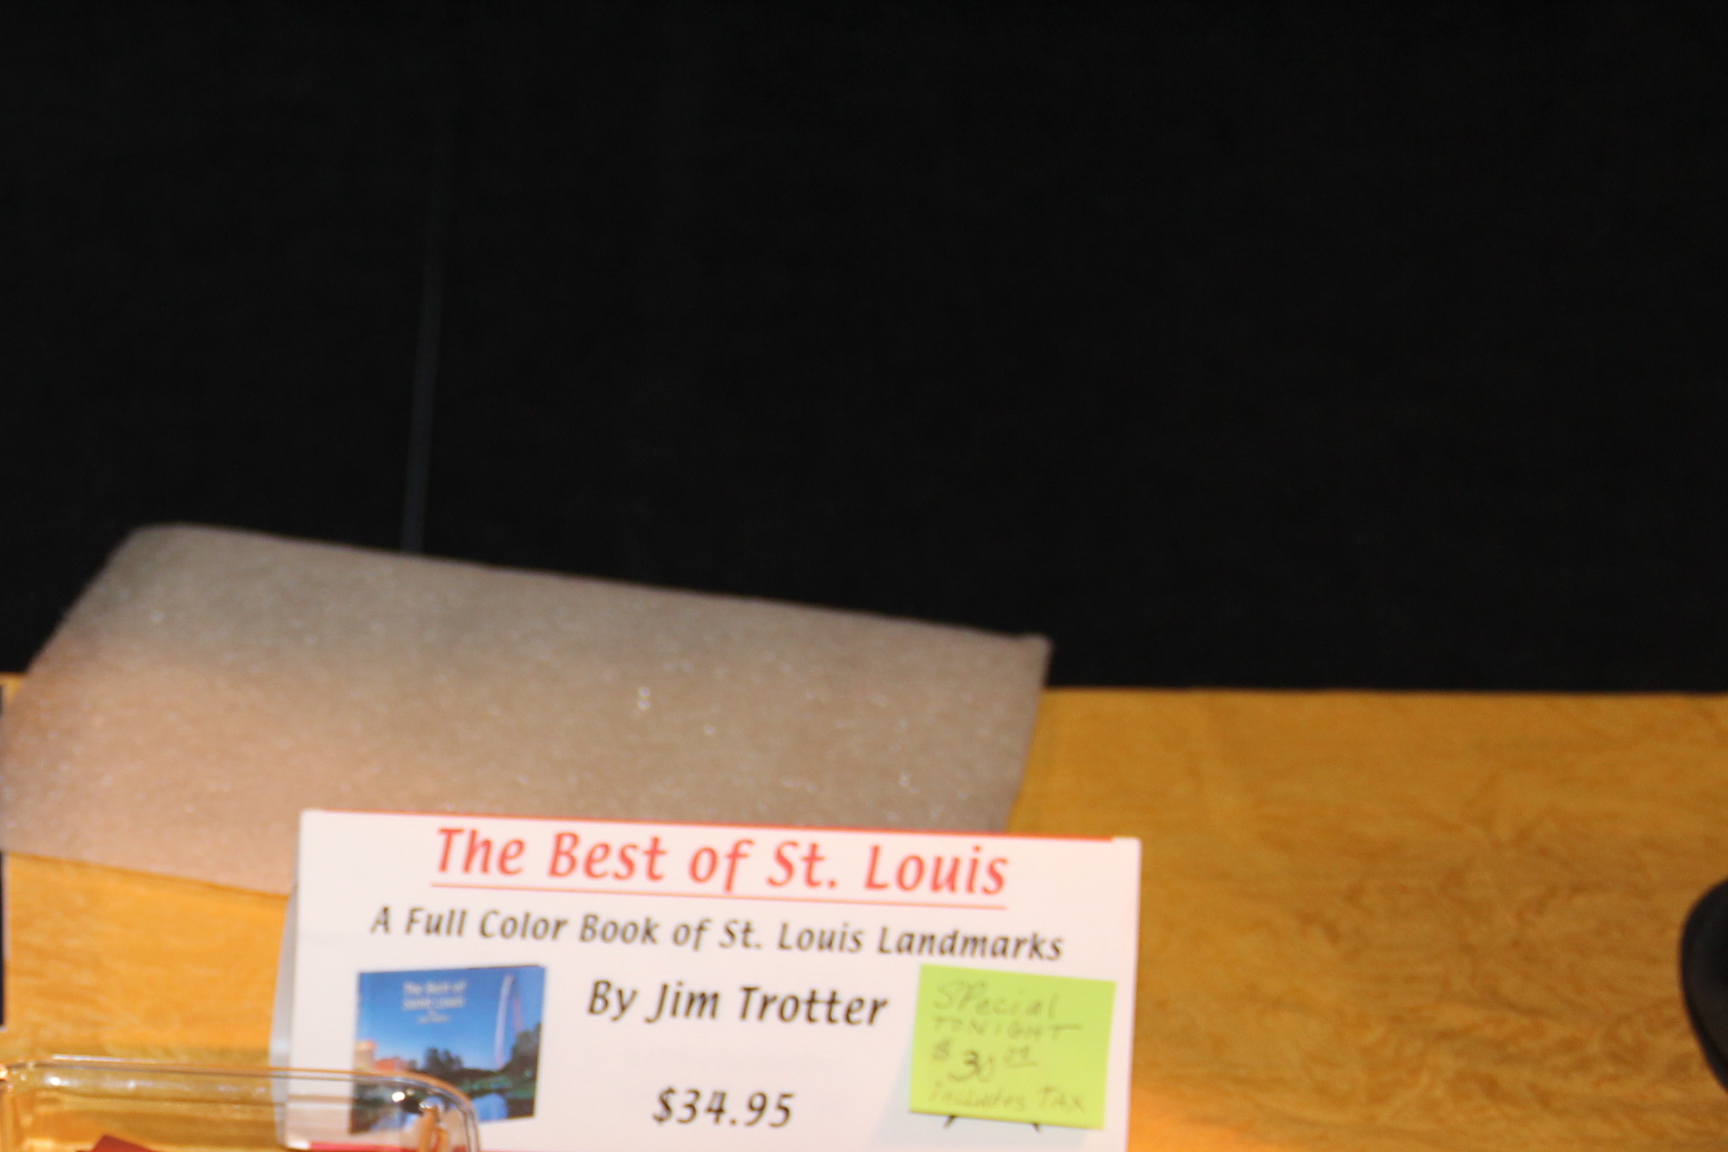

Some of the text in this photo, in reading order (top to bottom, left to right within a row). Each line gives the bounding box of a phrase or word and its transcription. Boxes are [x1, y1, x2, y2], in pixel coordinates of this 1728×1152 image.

[436, 828, 1008, 895] The Best of St. Louis
[371, 906, 1064, 962] A Full Color Book of St. Louis Landmarks
[587, 979, 889, 1027] By Jim Trotter
[651, 1087, 794, 1129] $34.95
